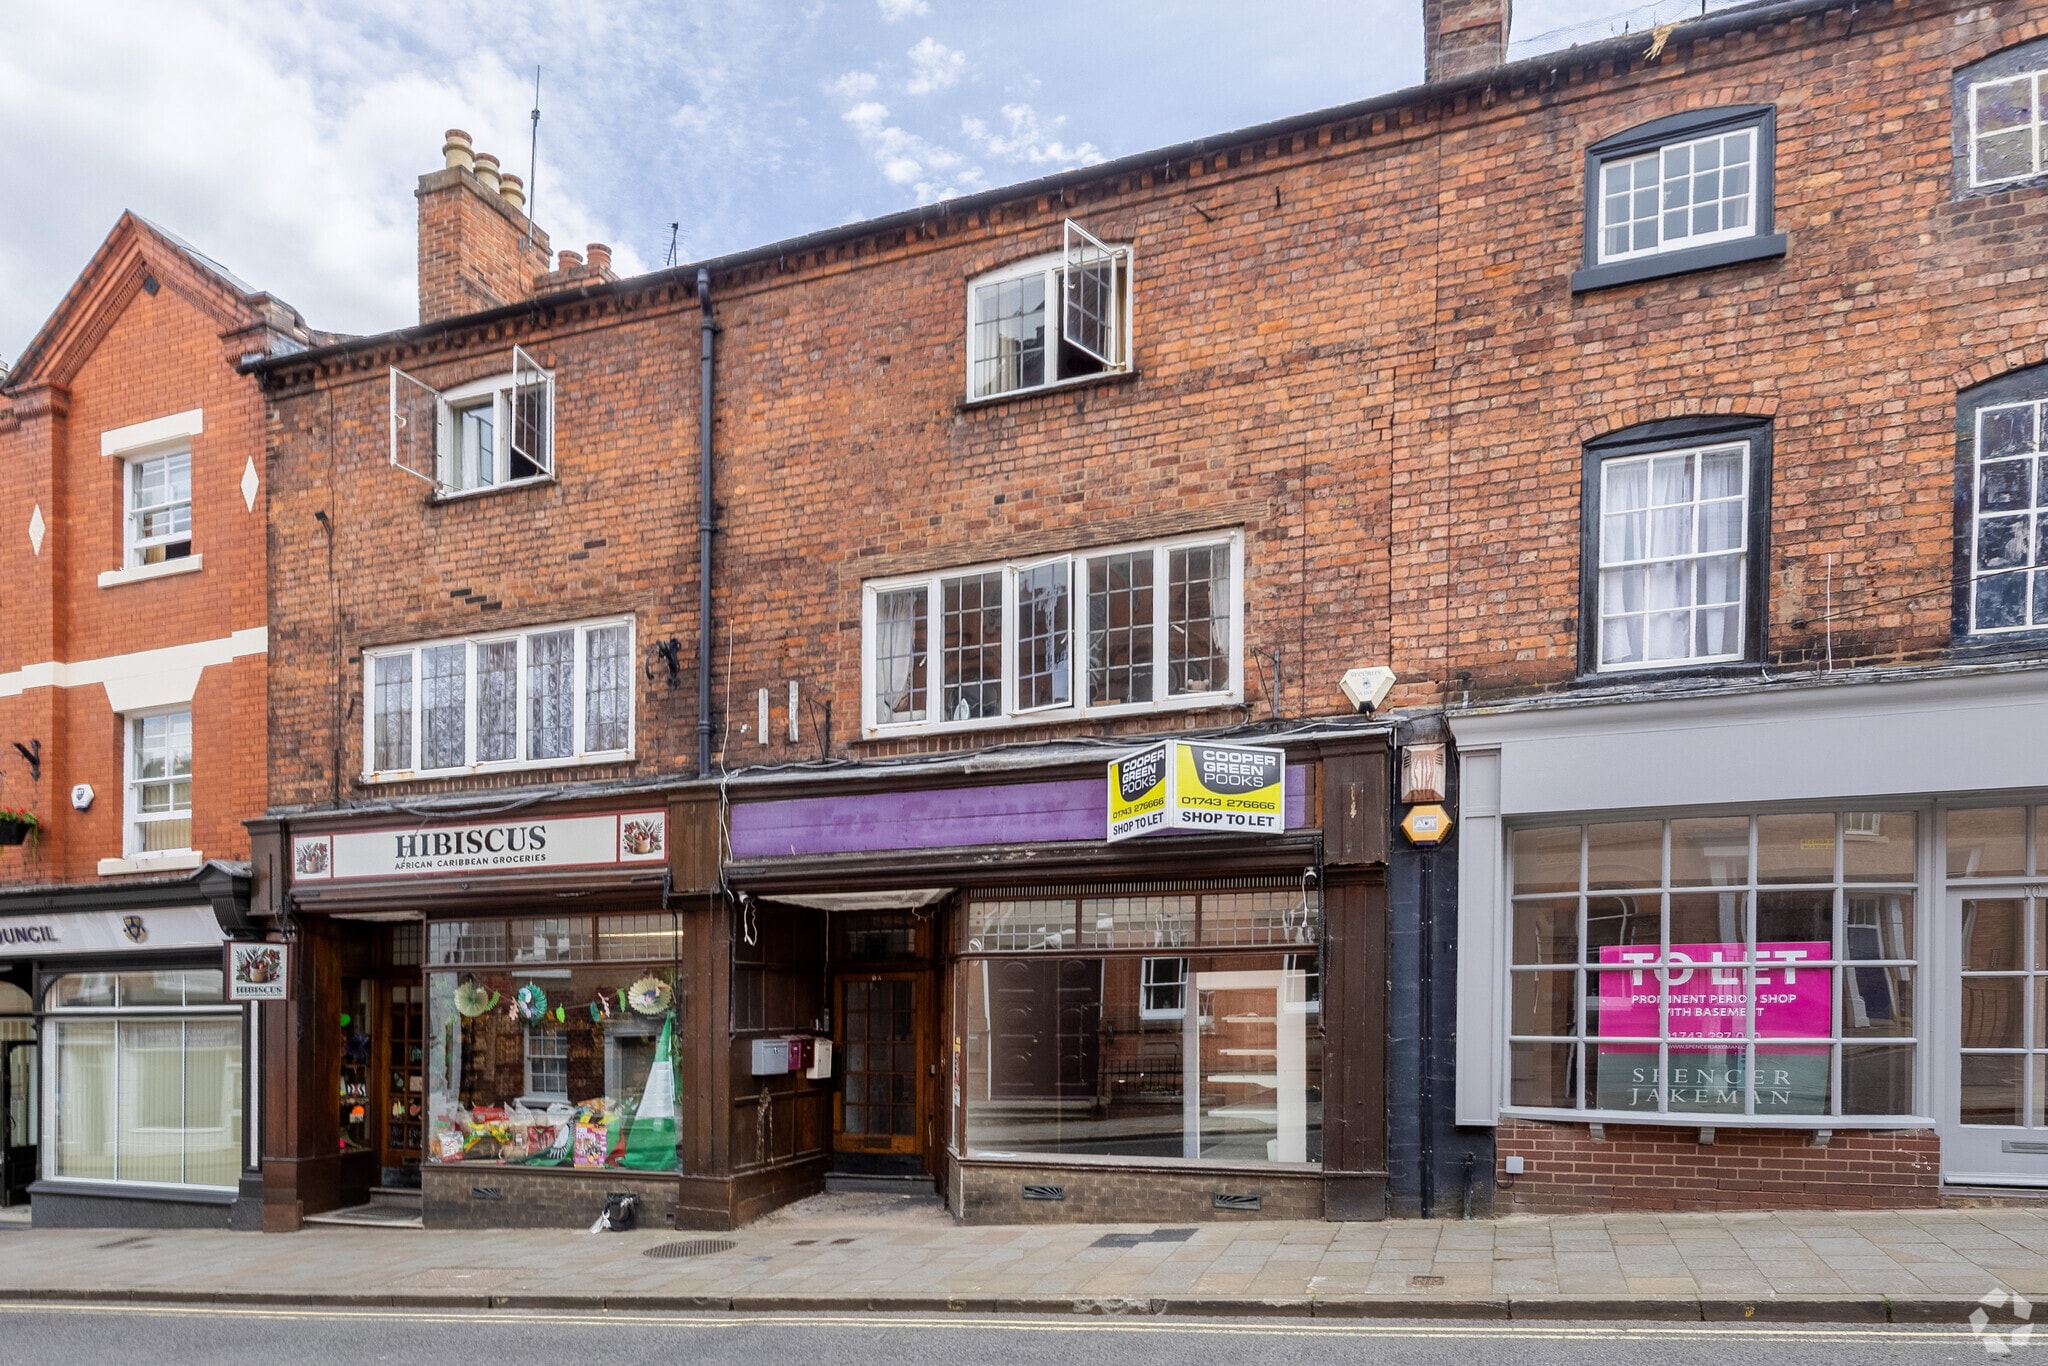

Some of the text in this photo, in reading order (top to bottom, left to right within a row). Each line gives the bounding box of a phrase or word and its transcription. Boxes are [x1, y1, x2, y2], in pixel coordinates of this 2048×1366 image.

[1122, 748, 1165, 773] COOPER
[1202, 750, 1276, 766] COOPER
[1122, 763, 1157, 784] GREEN
[1203, 762, 1263, 776] GREEN
[1122, 775, 1157, 796] POOKS
[1204, 773, 1264, 787] POOKS
[1113, 797, 1164, 819] 01743 276666
[1181, 796, 1275, 810] 01743 276666
[1113, 812, 1164, 836] SHOP TO LET
[1182, 811, 1275, 827] SHOP TO LET
[1414, 818, 1438, 829] ADT
[395, 825, 547, 859] HIBISCUS
[395, 854, 547, 870] AFRICAN CARIBBEAN GROCERIES
[2023, 885, 2042, 899] 10
[1622, 950, 1808, 986] TO LET
[1760, 994, 1797, 1004] SHOP
[1695, 1007, 1765, 1017] BASEMET
[1629, 1088, 1791, 1106] JAKEMAN
